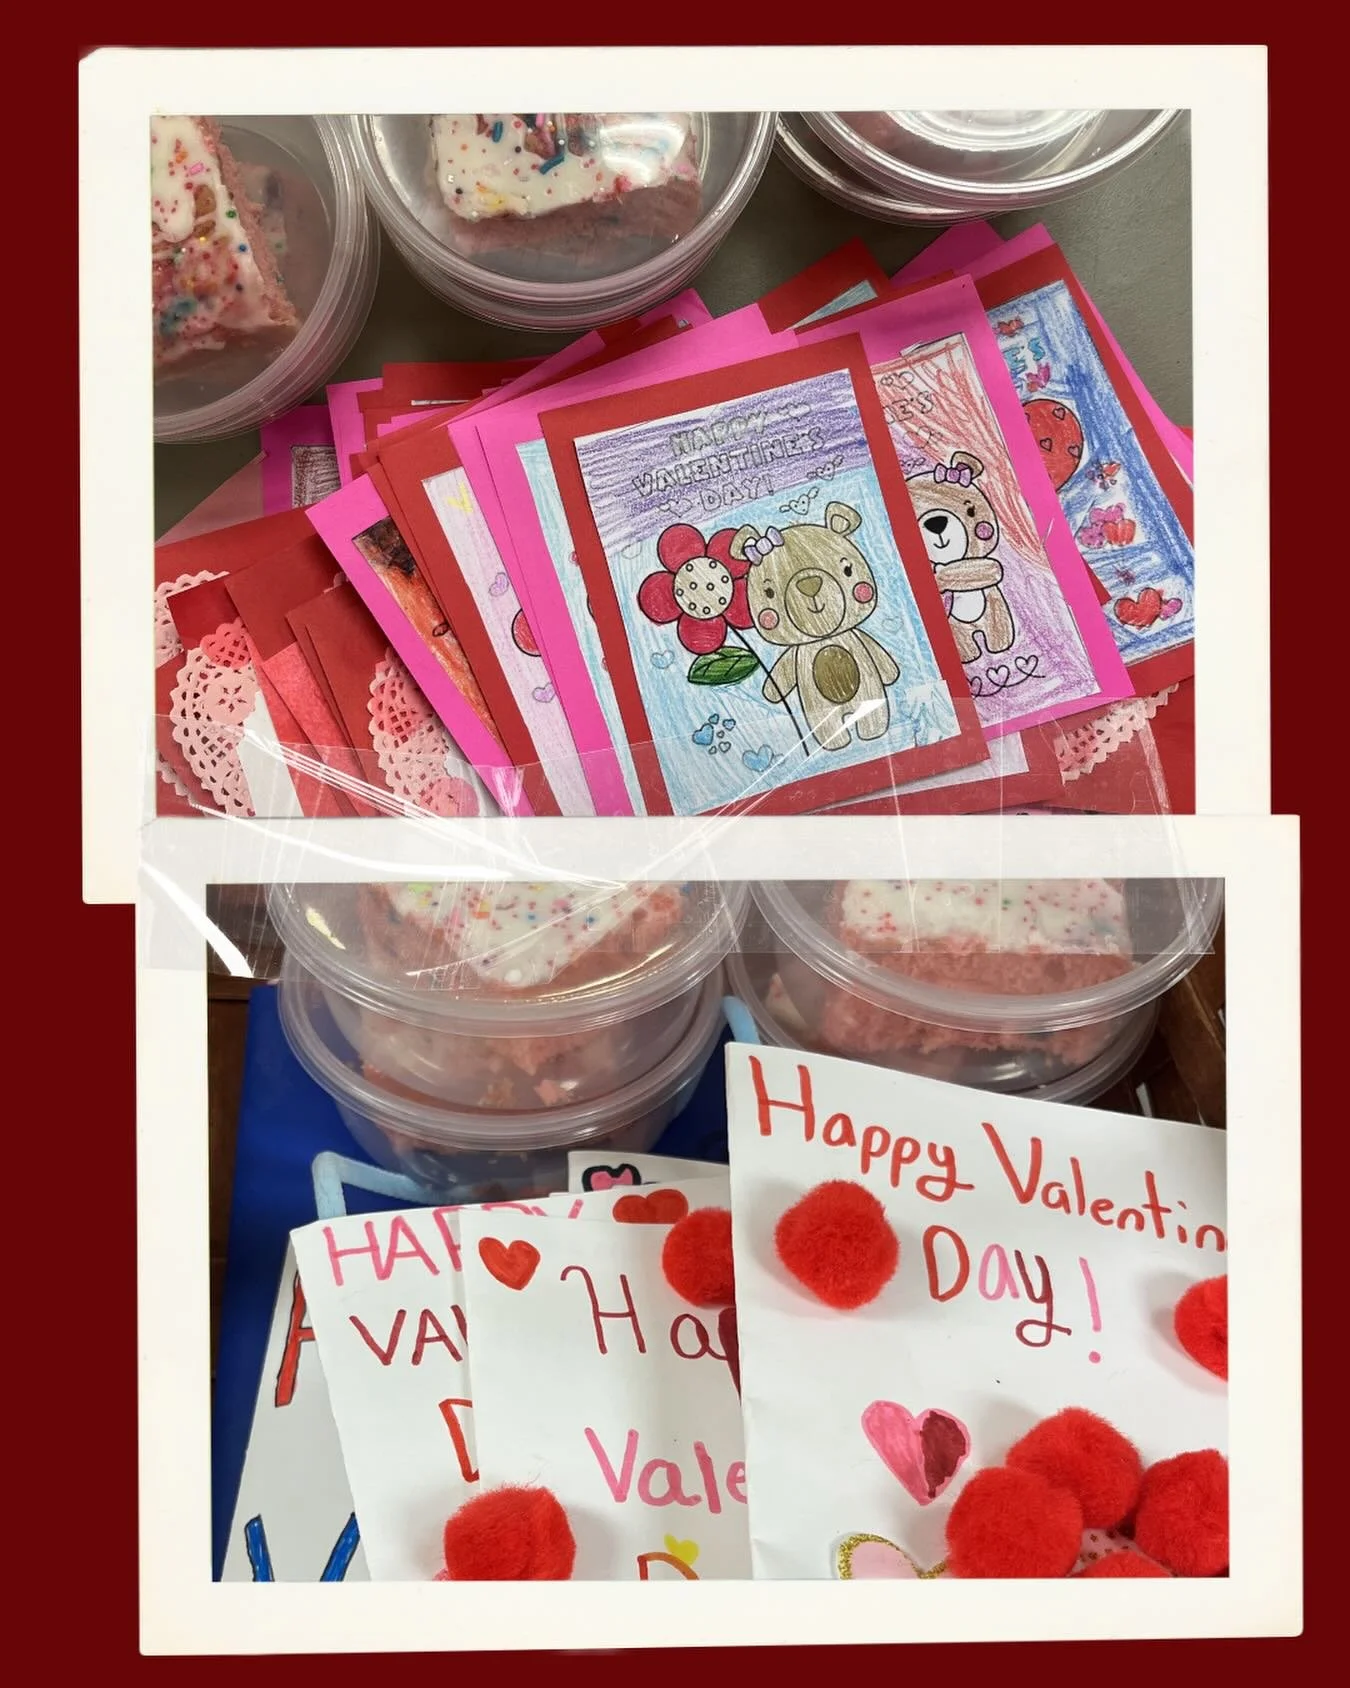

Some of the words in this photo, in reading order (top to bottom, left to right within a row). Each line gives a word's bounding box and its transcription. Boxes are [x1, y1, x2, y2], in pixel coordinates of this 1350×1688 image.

[633, 426, 825, 497] VALENTINE'S
[669, 410, 768, 458] HAPPY
[700, 473, 774, 512] DAY!
[748, 1055, 975, 1202] Happy
[921, 1223, 1102, 1364] Day!
[584, 1427, 748, 1514] Vale
